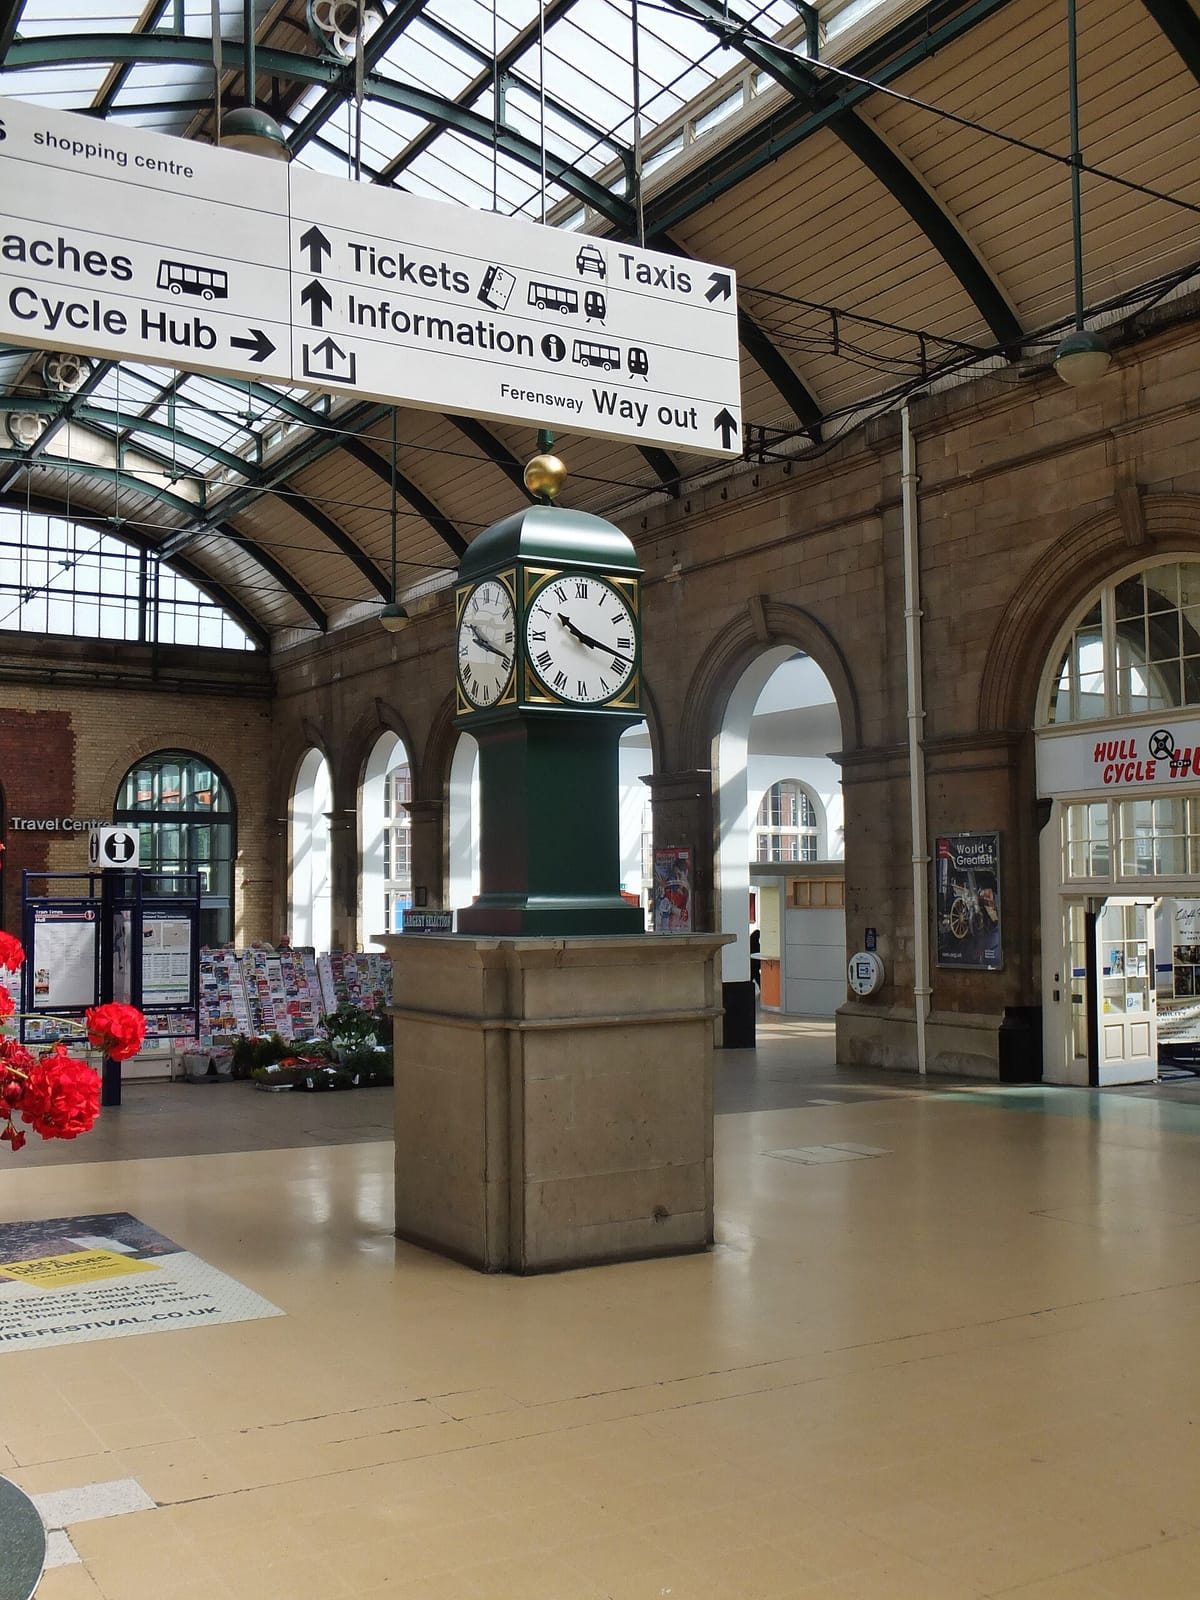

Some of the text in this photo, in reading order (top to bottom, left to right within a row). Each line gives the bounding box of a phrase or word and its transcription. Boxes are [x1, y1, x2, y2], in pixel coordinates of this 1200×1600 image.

[33, 131, 194, 178] shopping centre
[348, 242, 470, 294] Tickets
[618, 253, 692, 293] Taxis
[9, 286, 217, 350] Cycle Hub
[349, 294, 534, 357] Information
[500, 383, 698, 430] Ferensway Way out
[574, 583, 588, 599] XII
[1094, 739, 1137, 762] HULL
[1103, 760, 1156, 784] CYCLE
[11, 817, 111, 831] Travel Centre
[956, 843, 993, 855] World's
[956, 854, 993, 865] Greatest
[15, 1294, 56, 1302] days
[83, 1285, 130, 1295] world
[135, 1281, 178, 1289] class
[89, 1290, 140, 1300] visual
[97, 1297, 128, 1305] and
[26, 1310, 76, 1320] there
[81, 1300, 155, 1314] probably
[162, 1293, 213, 1304] aren't
